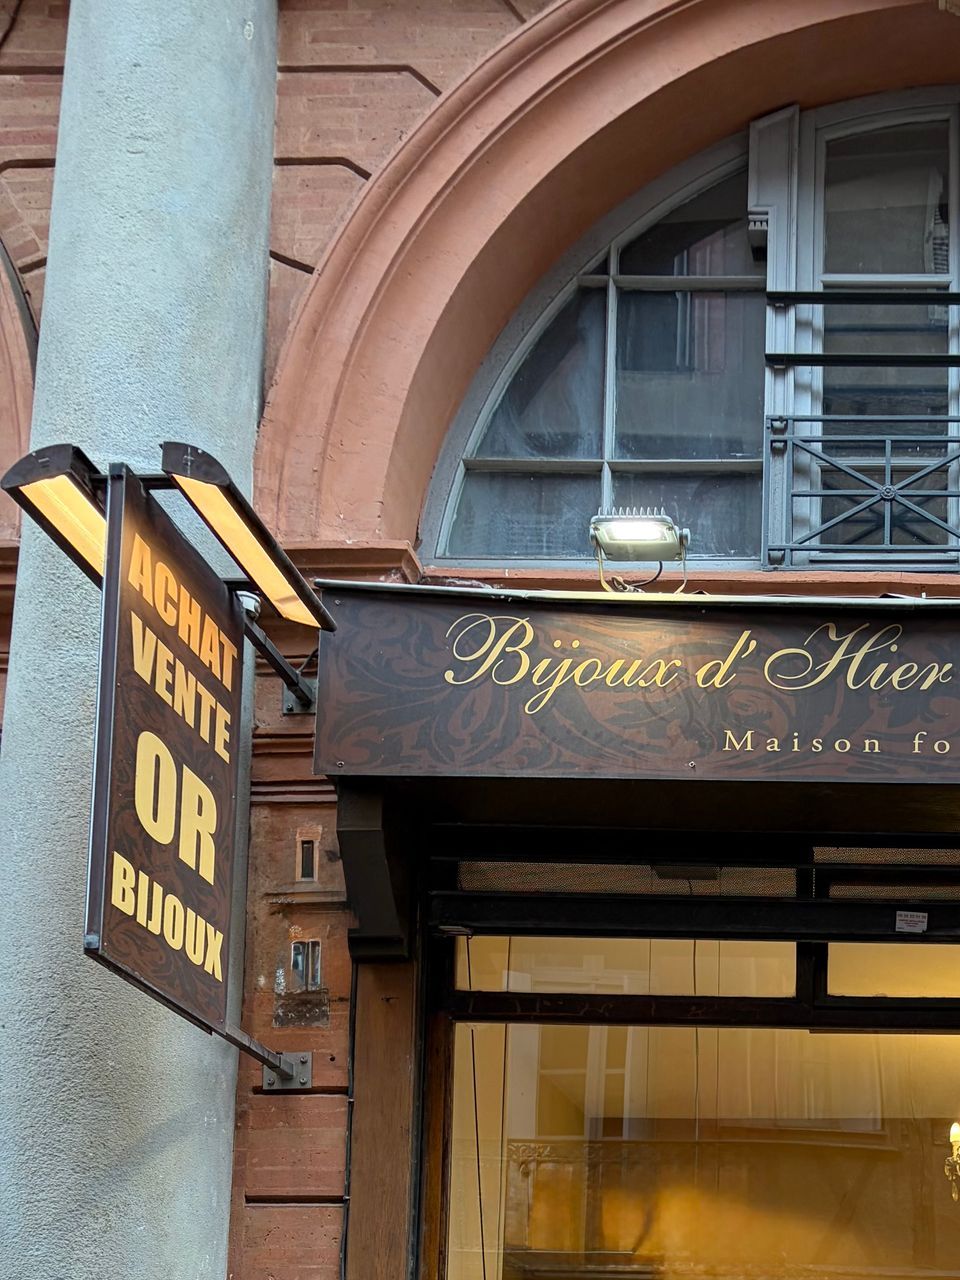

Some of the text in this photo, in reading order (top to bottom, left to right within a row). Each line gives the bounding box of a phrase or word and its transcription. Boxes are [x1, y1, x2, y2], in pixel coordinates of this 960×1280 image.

[128, 533, 237, 692] ACHAT
[443, 613, 682, 715] Bijoux
[131, 611, 232, 764] VENTE
[722, 729, 882, 754] Maison
[134, 731, 218, 886] OR
[111, 851, 224, 982] BIJOUX
